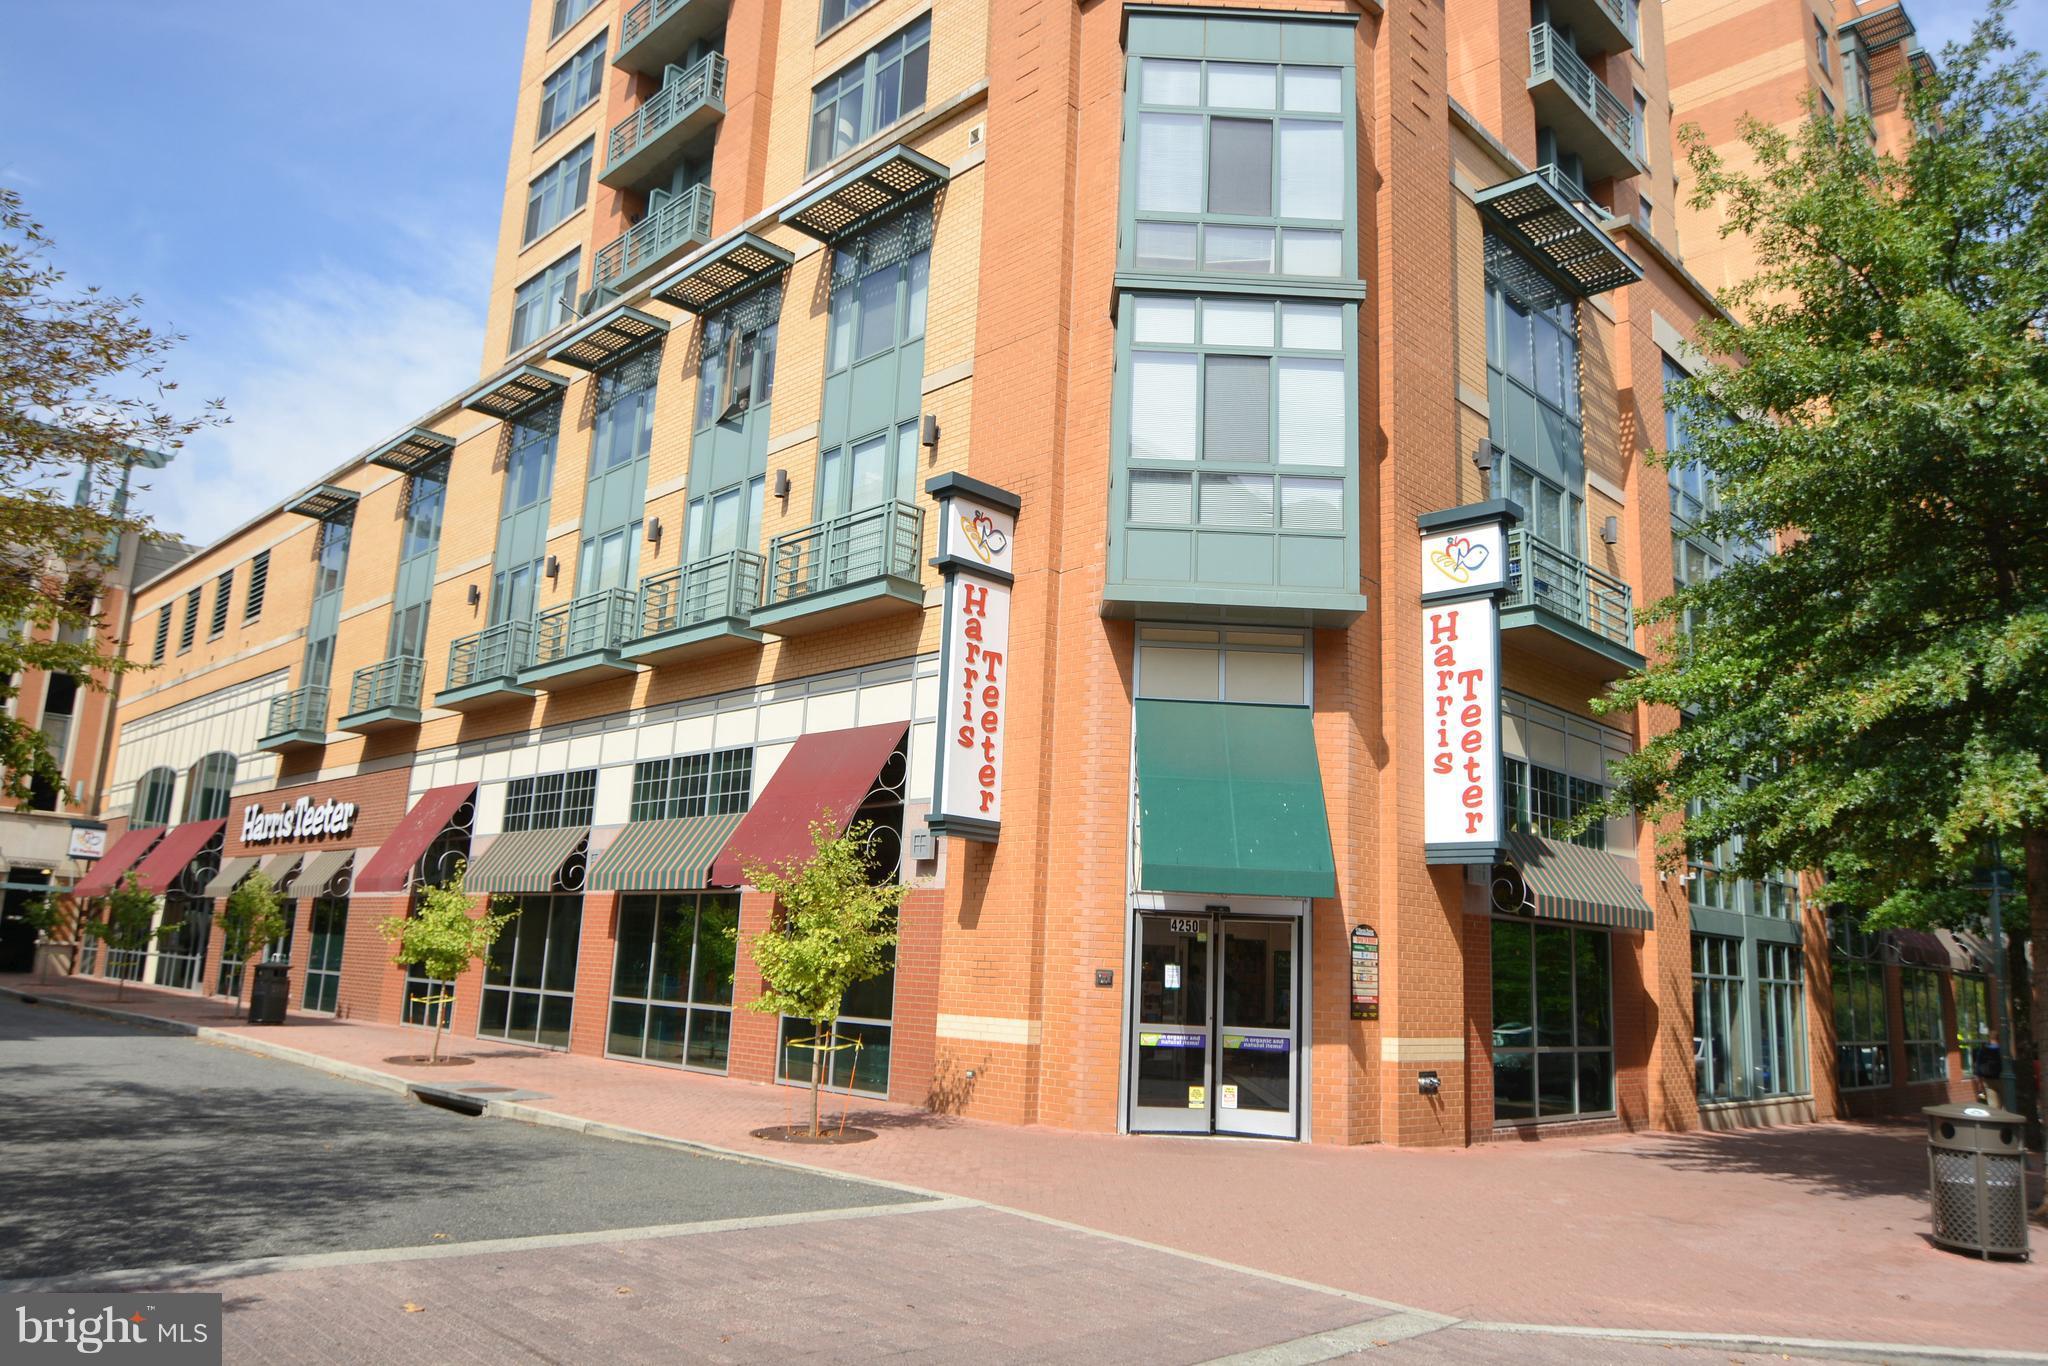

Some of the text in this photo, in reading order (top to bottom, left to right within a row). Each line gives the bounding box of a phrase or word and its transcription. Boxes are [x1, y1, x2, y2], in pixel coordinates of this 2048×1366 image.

[957, 583, 1002, 814] Harris Teeter
[1430, 611, 1484, 834] Harris Teeter
[240, 796, 355, 841] Harris Teeter
[1171, 919, 1198, 932] 4250
